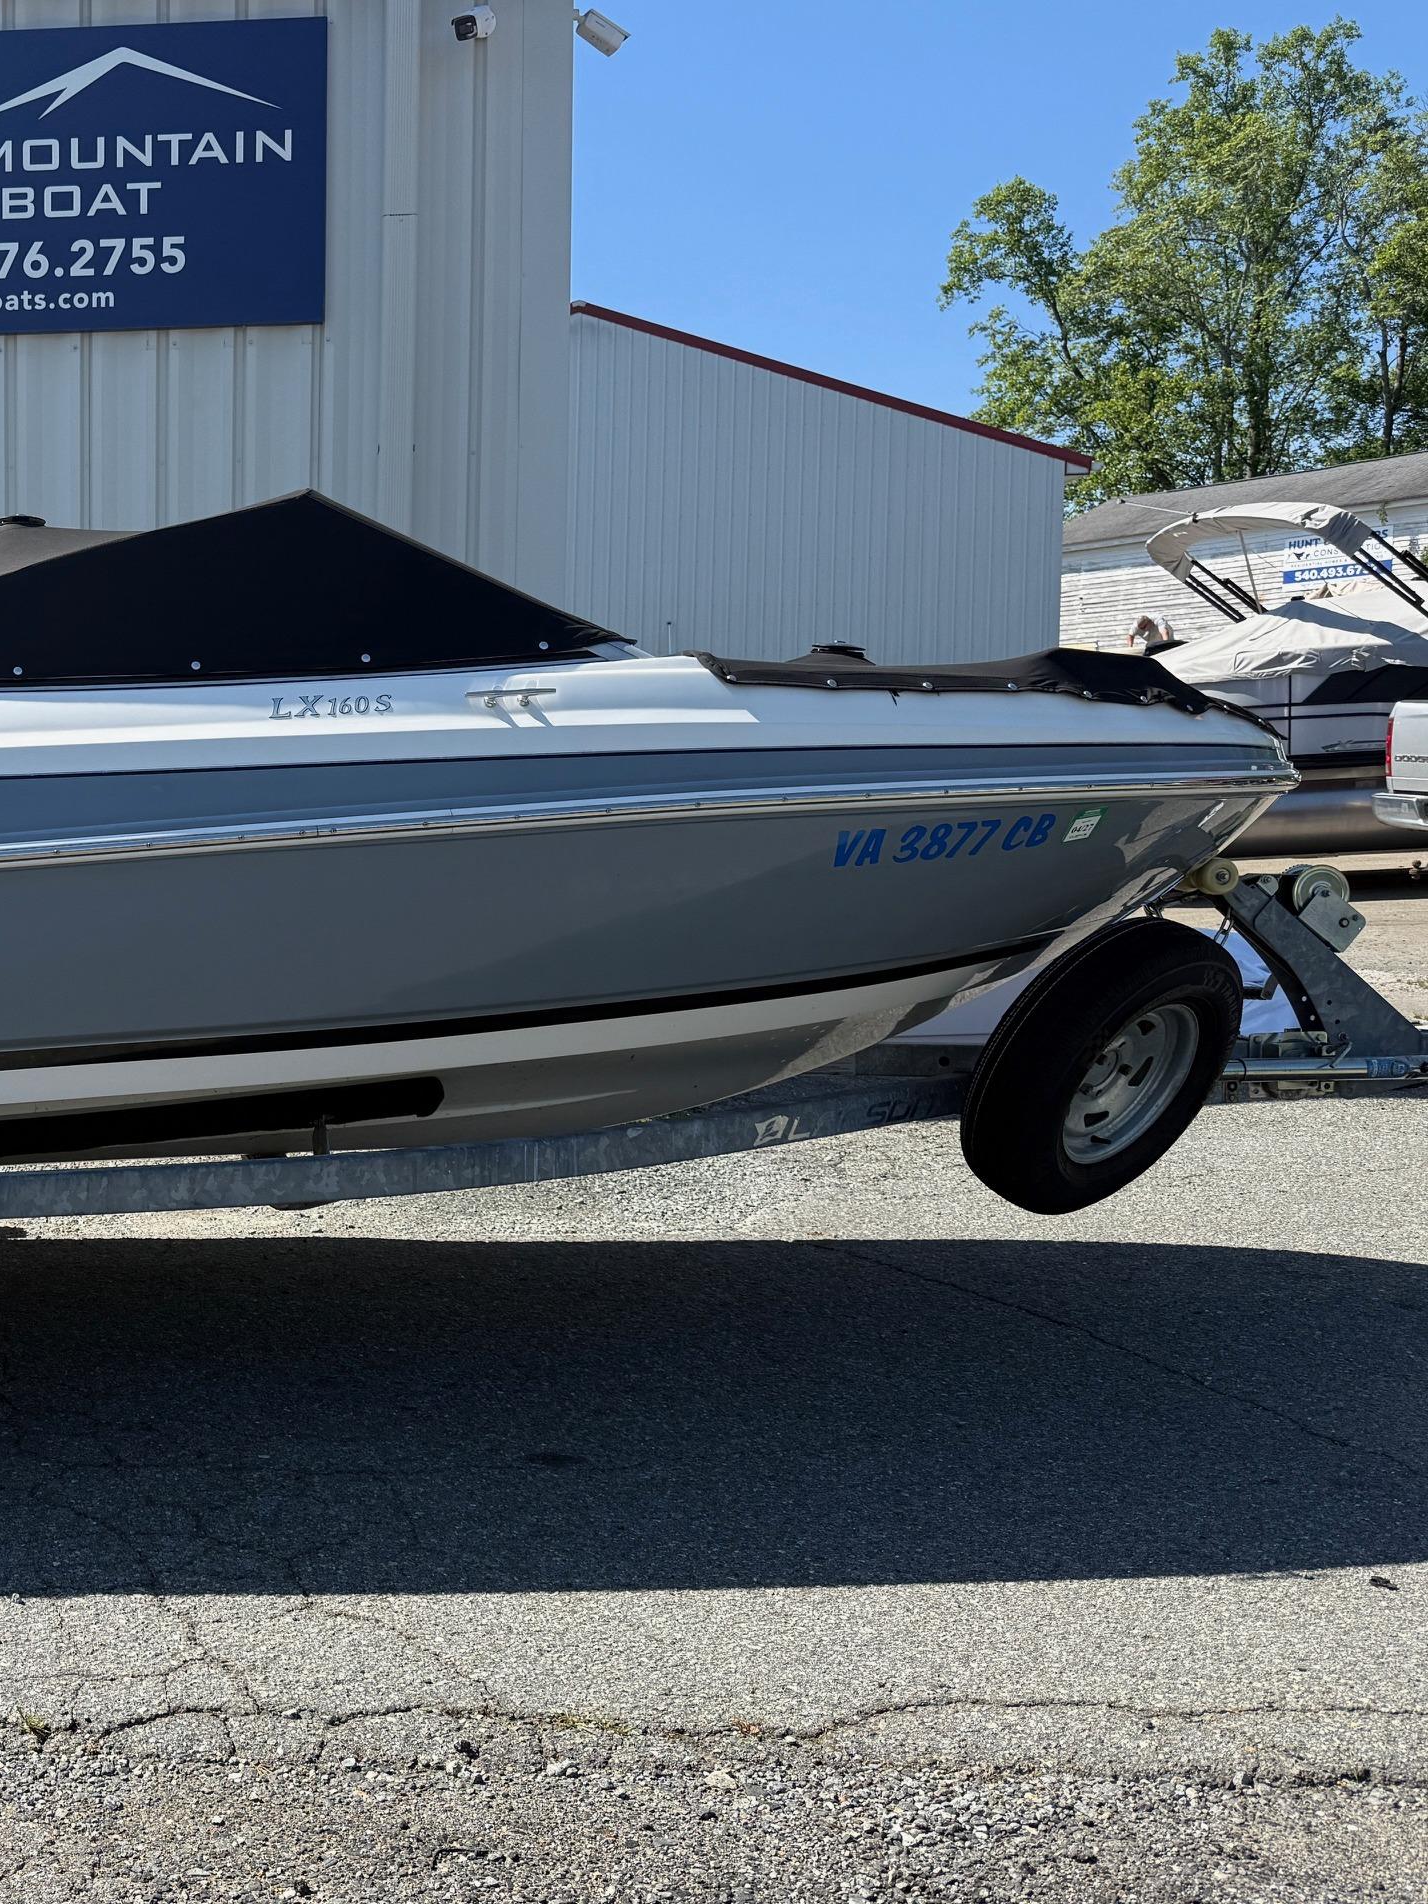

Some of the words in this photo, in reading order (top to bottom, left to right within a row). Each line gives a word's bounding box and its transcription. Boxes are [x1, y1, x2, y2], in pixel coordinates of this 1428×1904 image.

[1, 181, 162, 220] BOAT
[1288, 537, 1321, 550] HUNT
[833, 828, 887, 867] VA
[892, 818, 1002, 864] 3877
[1001, 813, 1057, 851] CB
